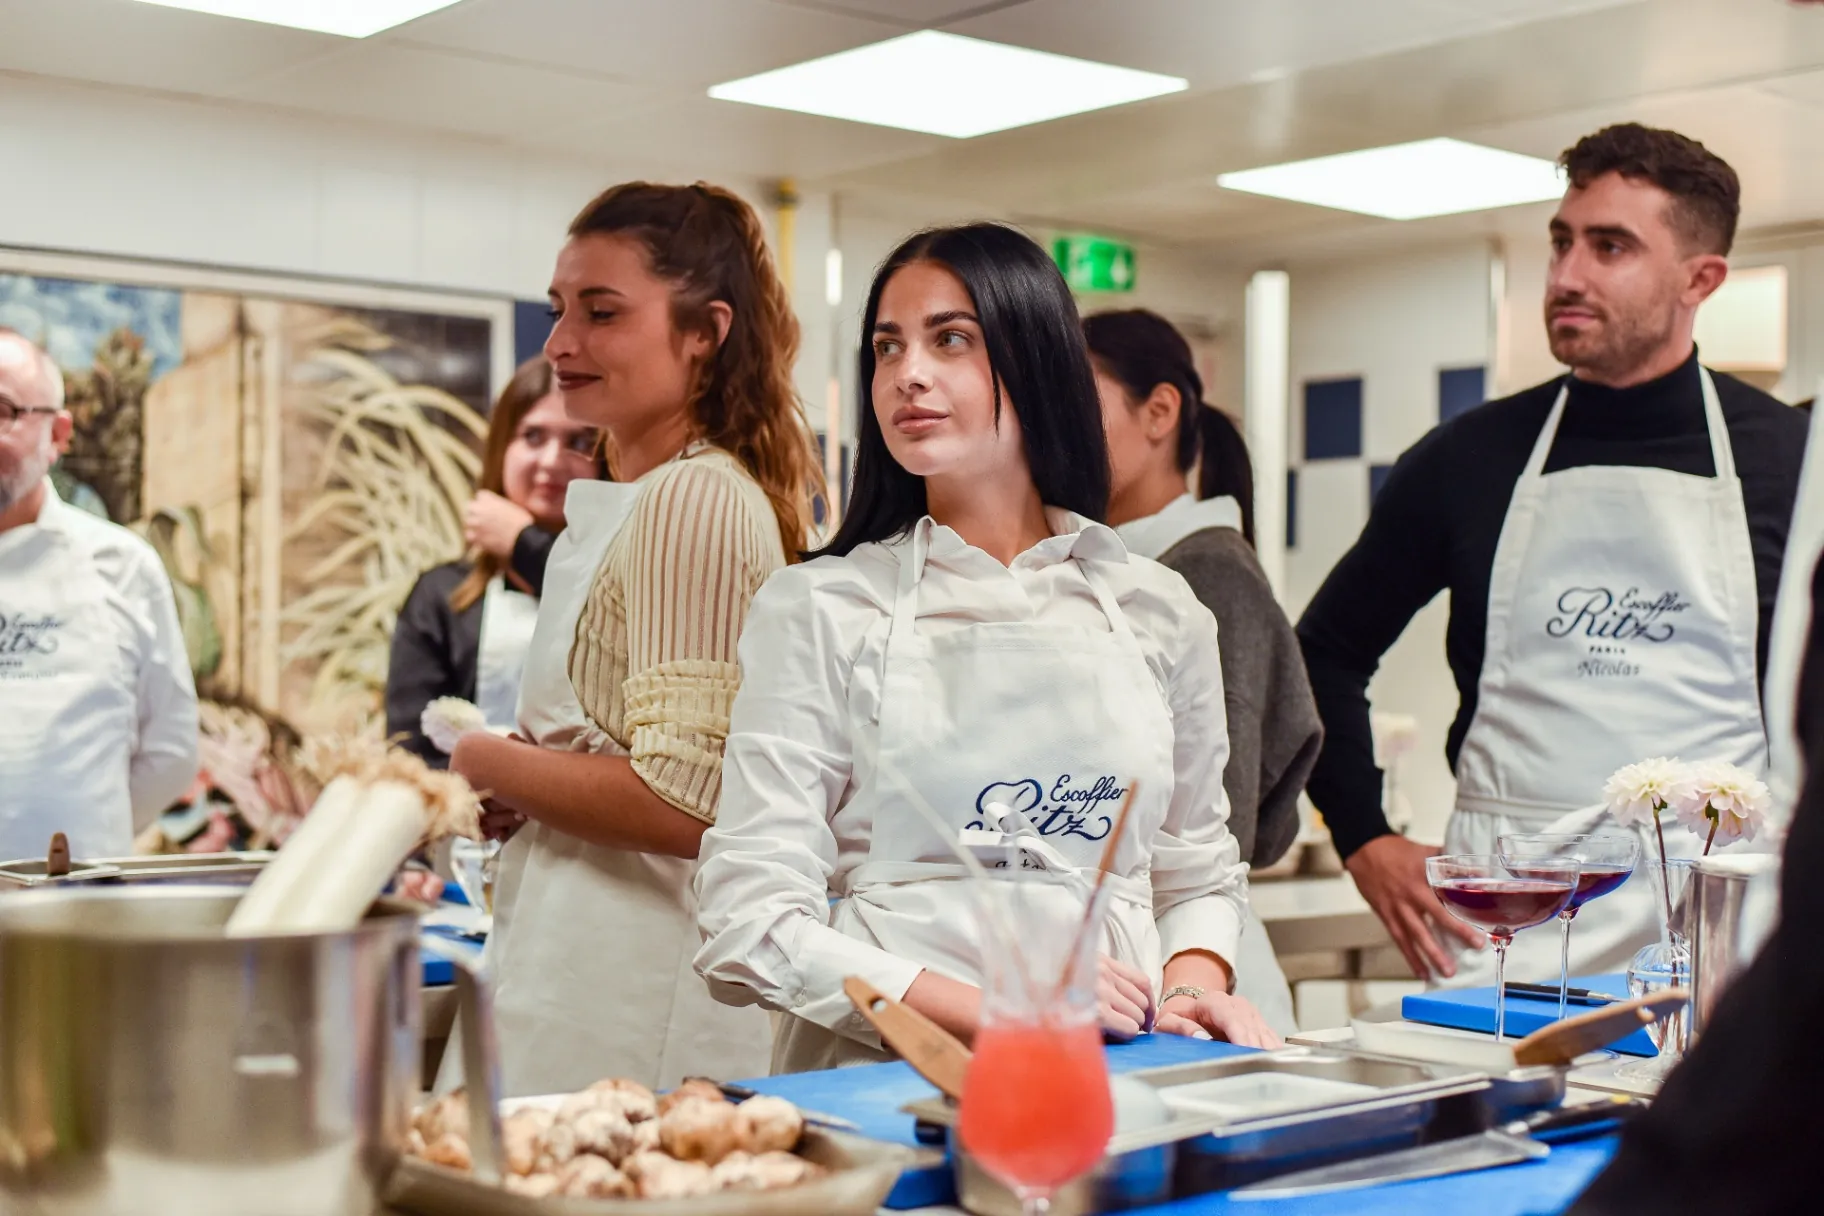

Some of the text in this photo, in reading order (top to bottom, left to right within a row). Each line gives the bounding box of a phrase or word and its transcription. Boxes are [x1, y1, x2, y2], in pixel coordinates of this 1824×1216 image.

[1547, 587, 1674, 642] Ritz
[1619, 587, 1691, 620] Escoffier
[1577, 659, 1640, 678] Nicolas
[1050, 774, 1128, 814] Escoffier
